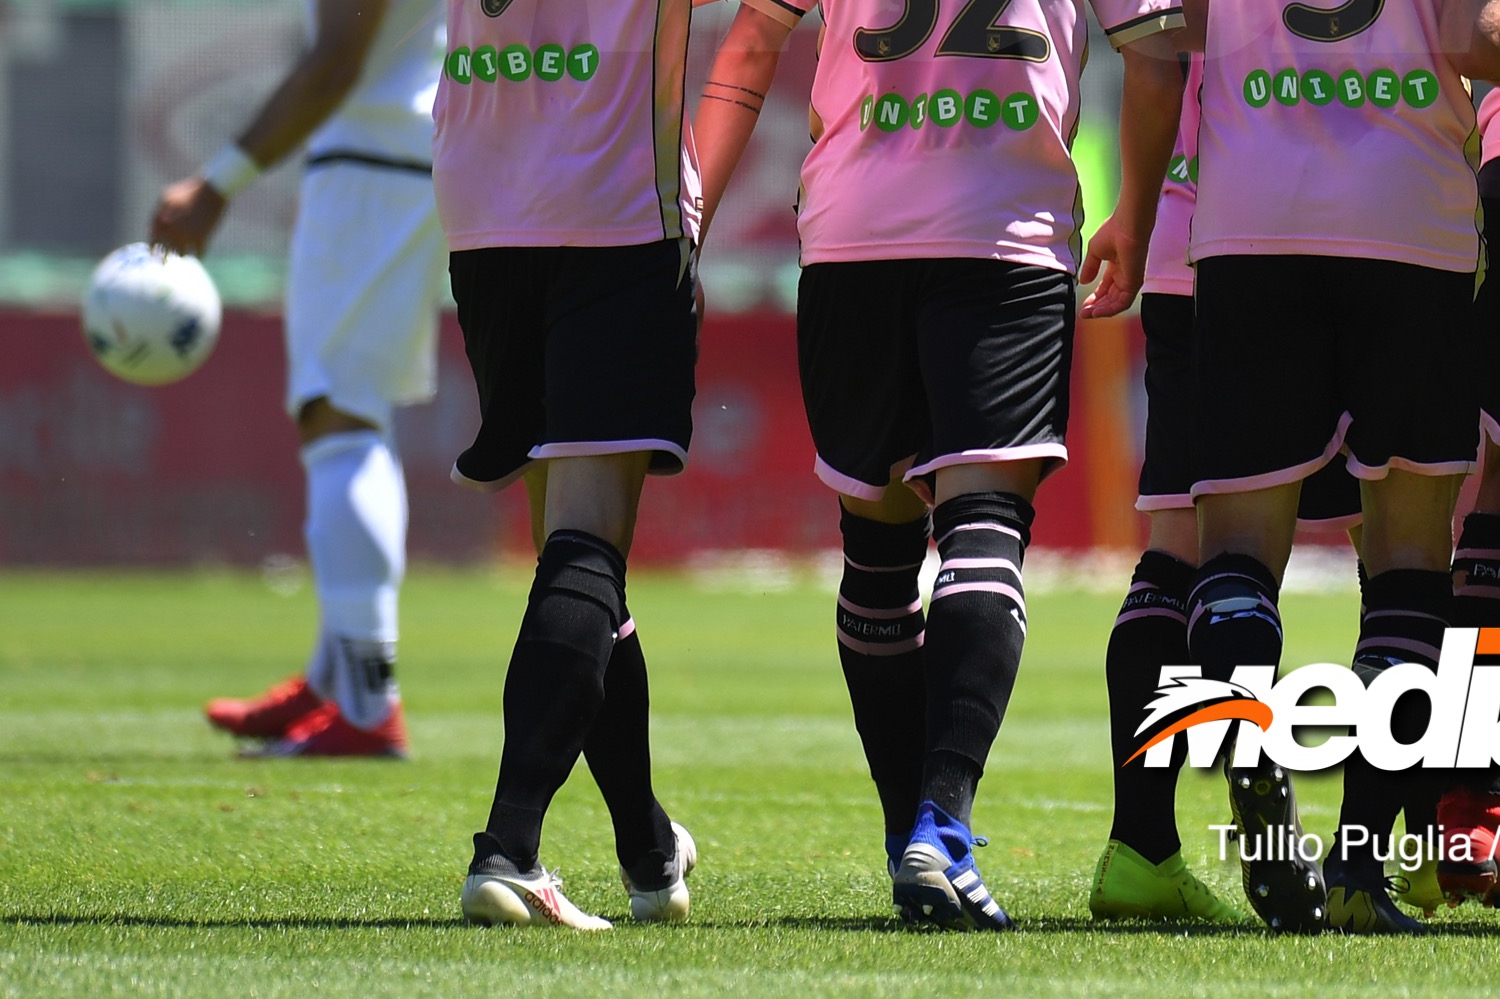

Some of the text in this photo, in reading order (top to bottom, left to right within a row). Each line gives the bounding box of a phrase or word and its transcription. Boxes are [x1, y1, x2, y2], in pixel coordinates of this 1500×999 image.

[456, 50, 594, 78] NIBET
[1248, 74, 1429, 104] UNIBET
[861, 95, 1030, 126] UNIBET
